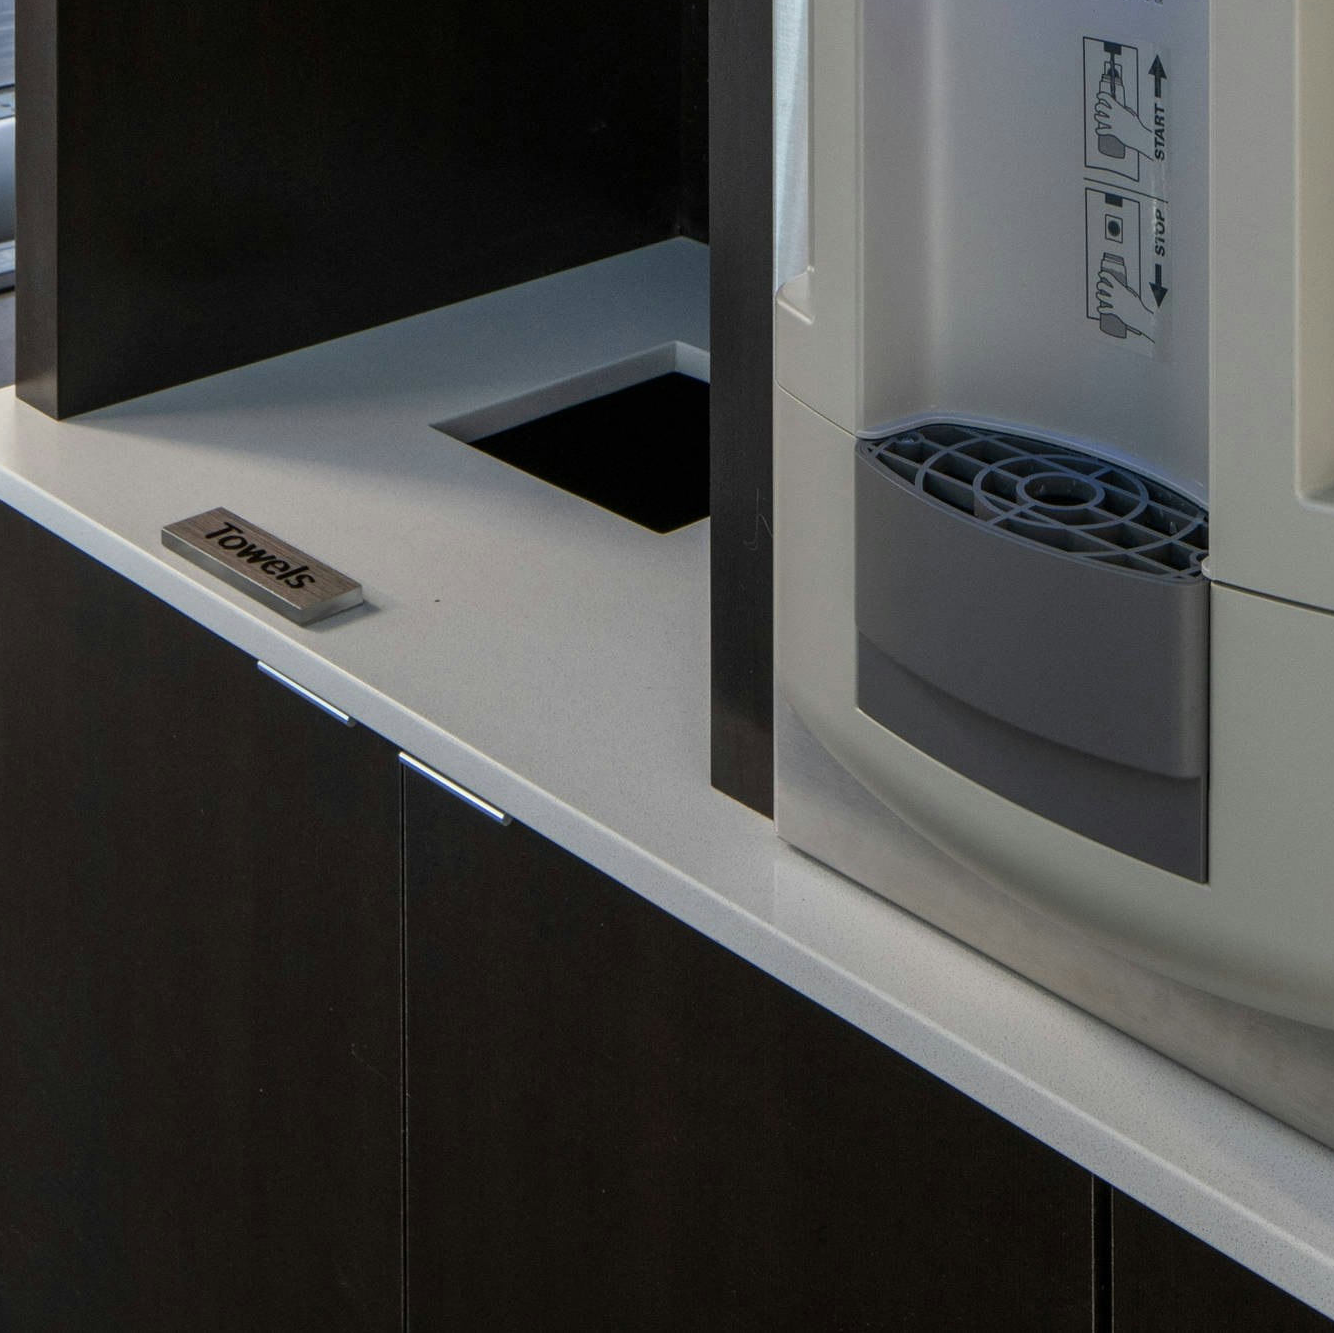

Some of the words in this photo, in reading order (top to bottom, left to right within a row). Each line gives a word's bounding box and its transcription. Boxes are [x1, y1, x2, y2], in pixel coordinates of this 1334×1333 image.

[1153, 105, 1167, 161] START
[1153, 208, 1167, 257] STOP
[204, 521, 316, 589] Towels
